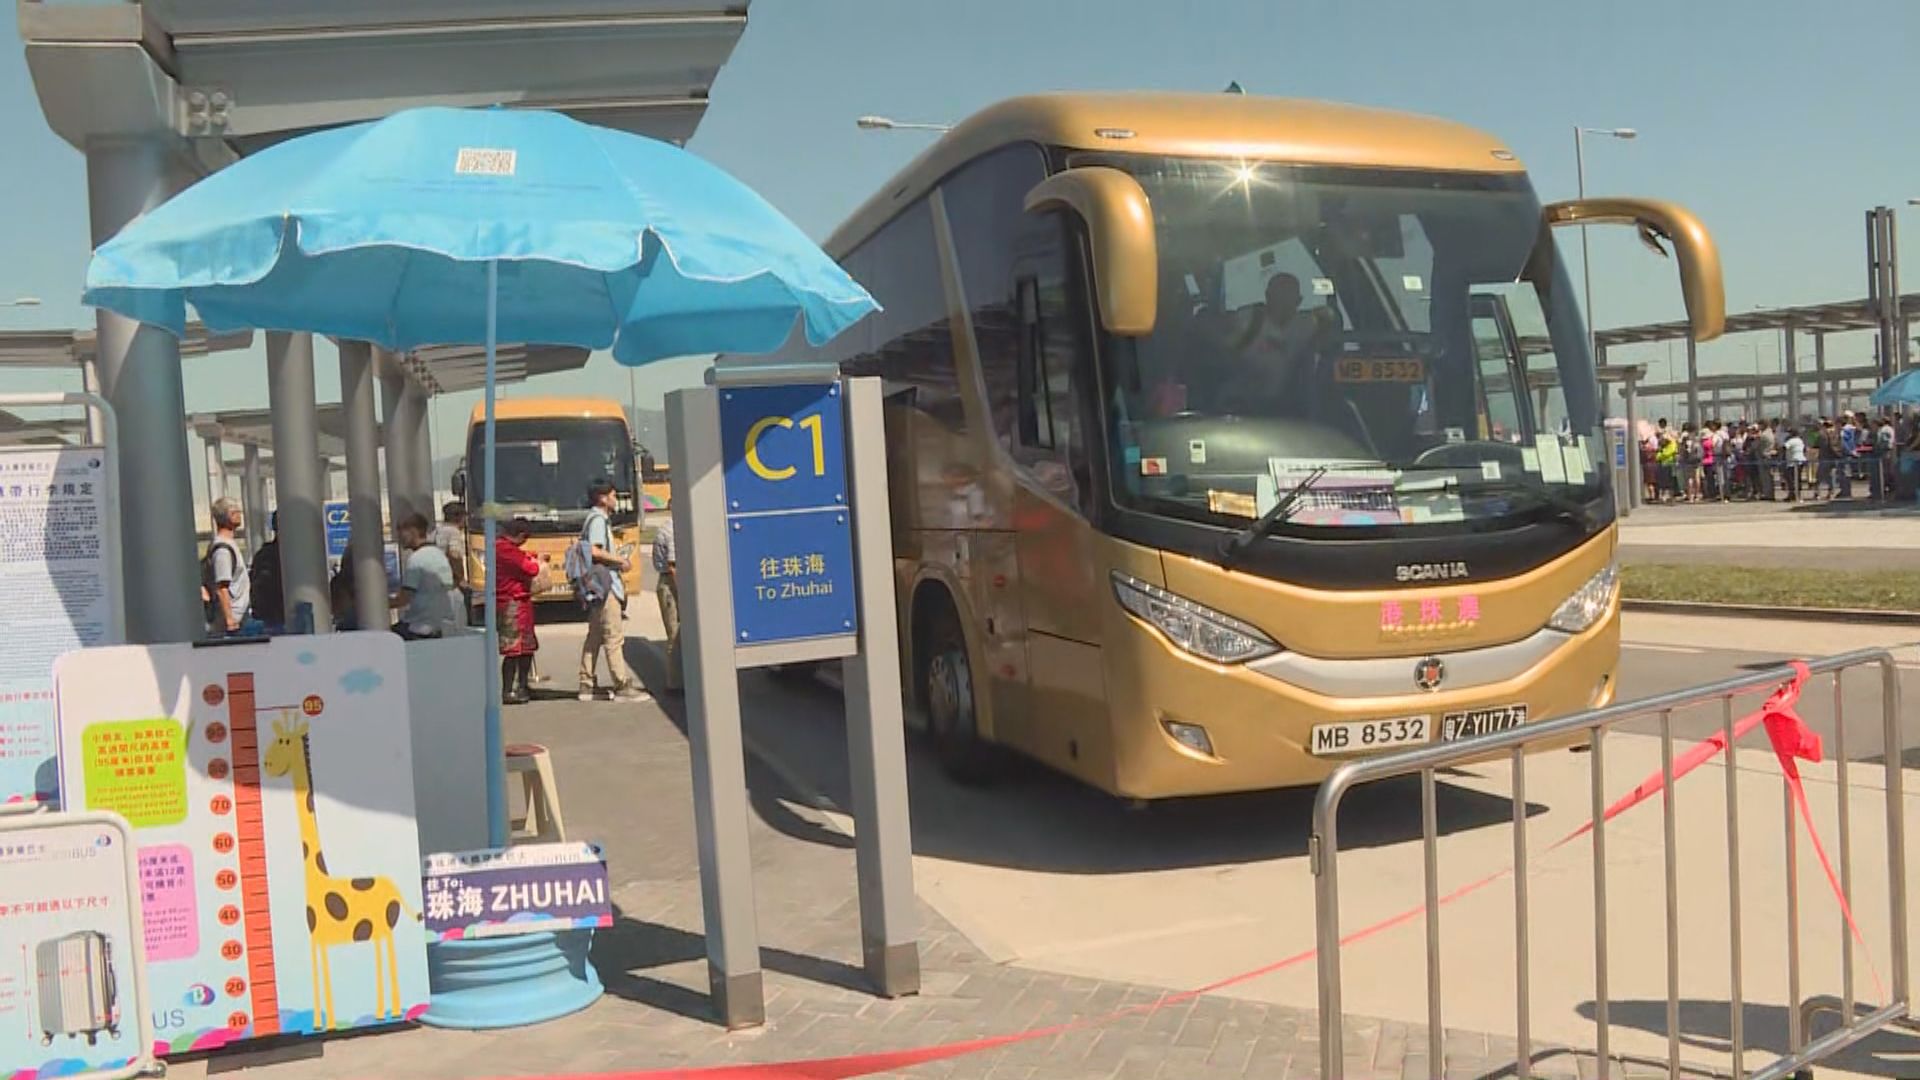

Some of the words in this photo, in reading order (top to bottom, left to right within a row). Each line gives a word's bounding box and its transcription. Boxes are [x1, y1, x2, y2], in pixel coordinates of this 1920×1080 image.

[744, 413, 825, 481] C1
[327, 510, 351, 525] C2
[760, 554, 825, 579] 往珠海
[1396, 562, 1469, 581] SCANIA
[755, 585, 776, 601] To
[781, 580, 832, 599] Zhuhai
[1381, 594, 1480, 626] 港珠澳
[304, 700, 322, 712] 95
[1318, 726, 1350, 750] MB
[1362, 719, 1424, 744] 8532
[212, 800, 230, 811] 70
[214, 837, 232, 848] 60
[217, 874, 236, 885] 50
[427, 880, 440, 892] 往
[443, 877, 464, 889] To:
[427, 886, 484, 921] 珠海
[491, 878, 605, 912] ZHUHAI
[220, 909, 239, 920] 40
[223, 945, 242, 956] 30
[226, 981, 245, 993] 20
[229, 1015, 247, 1026] 10
